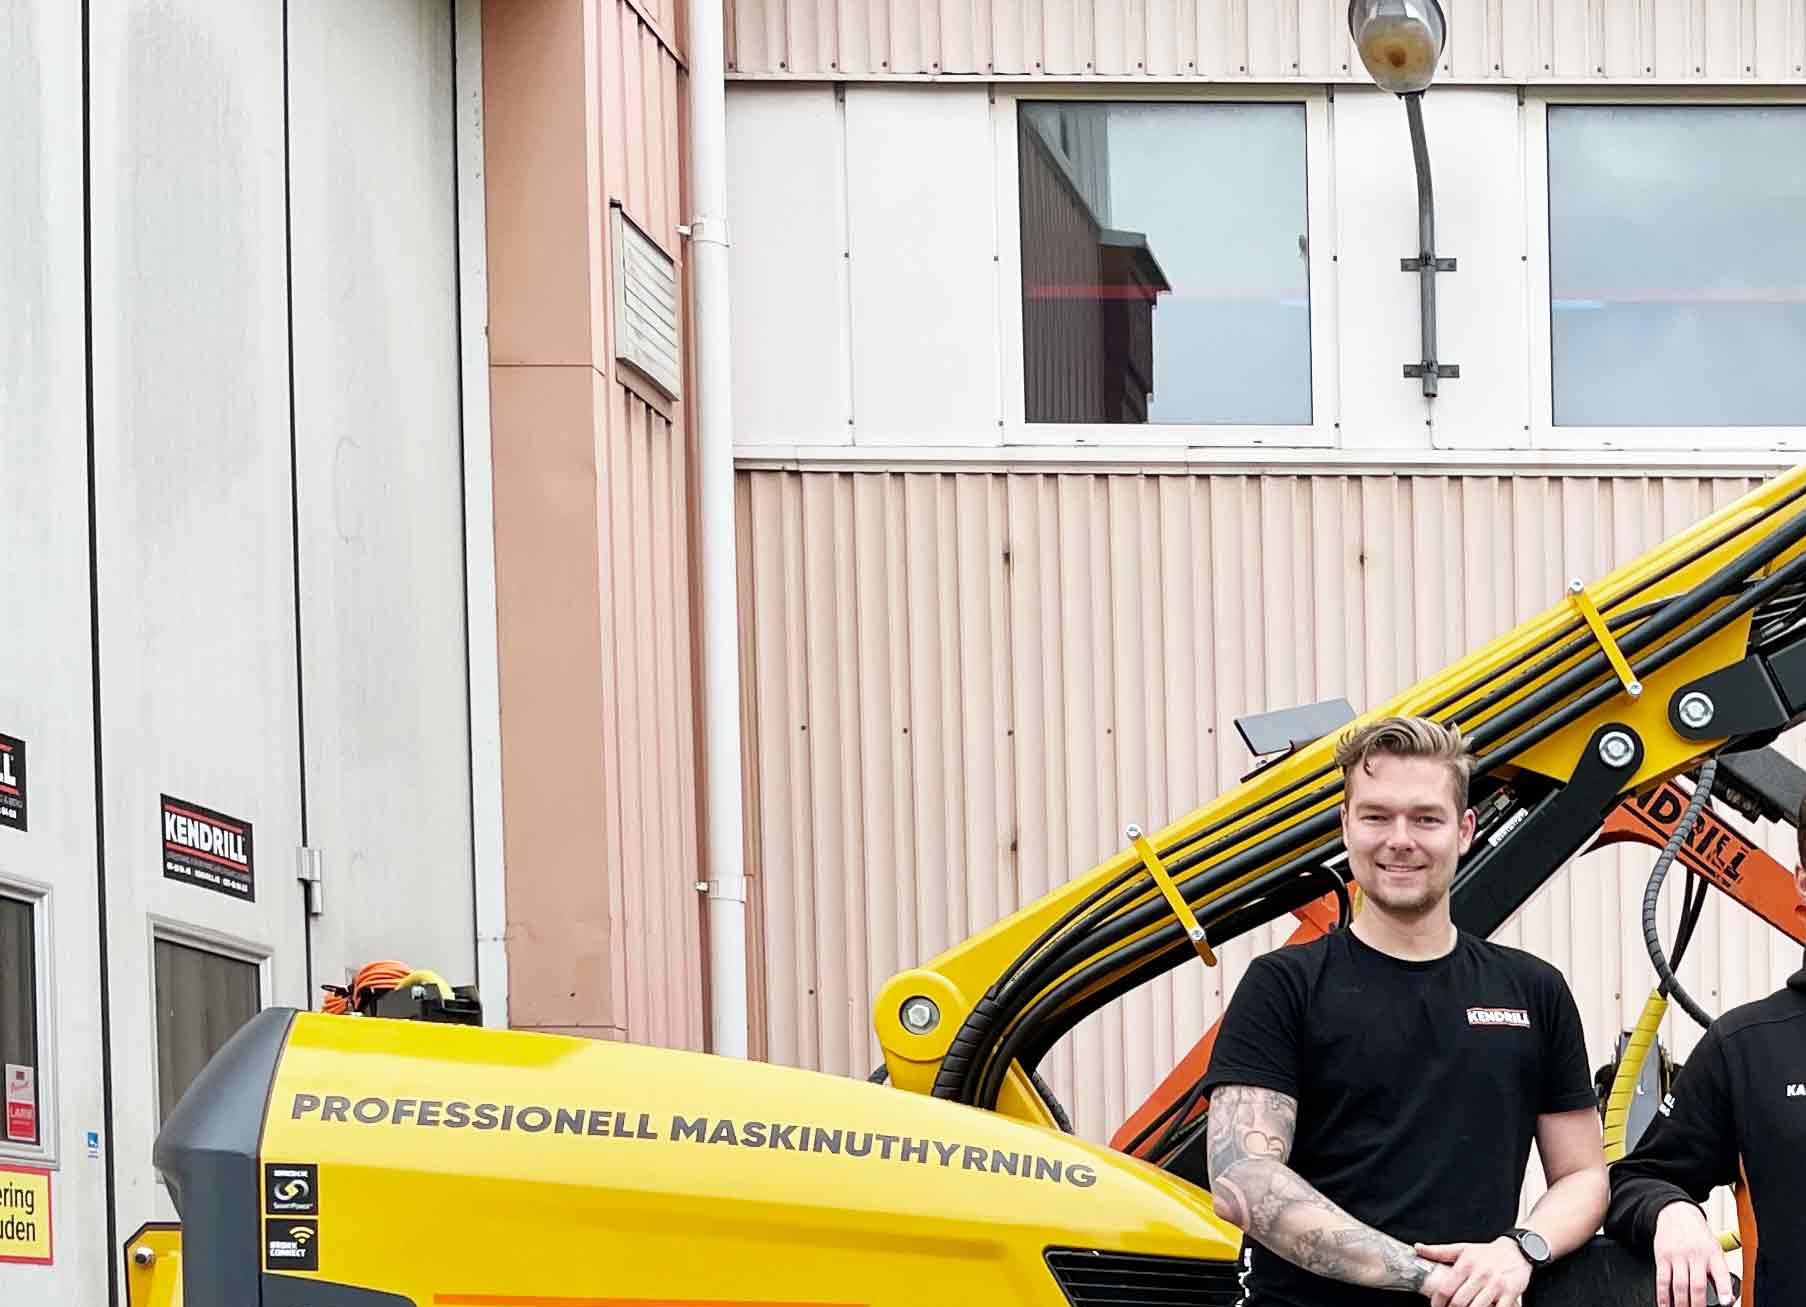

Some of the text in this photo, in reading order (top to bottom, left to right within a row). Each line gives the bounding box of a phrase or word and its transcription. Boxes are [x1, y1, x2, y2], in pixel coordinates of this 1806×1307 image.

[165, 811, 248, 864] KENDRILL
[1467, 1010, 1531, 1025] KENDRILL
[291, 1093, 1098, 1188] PROFESSIONELL MASKINUTHYRNING
[0, 1182, 34, 1215] ring
